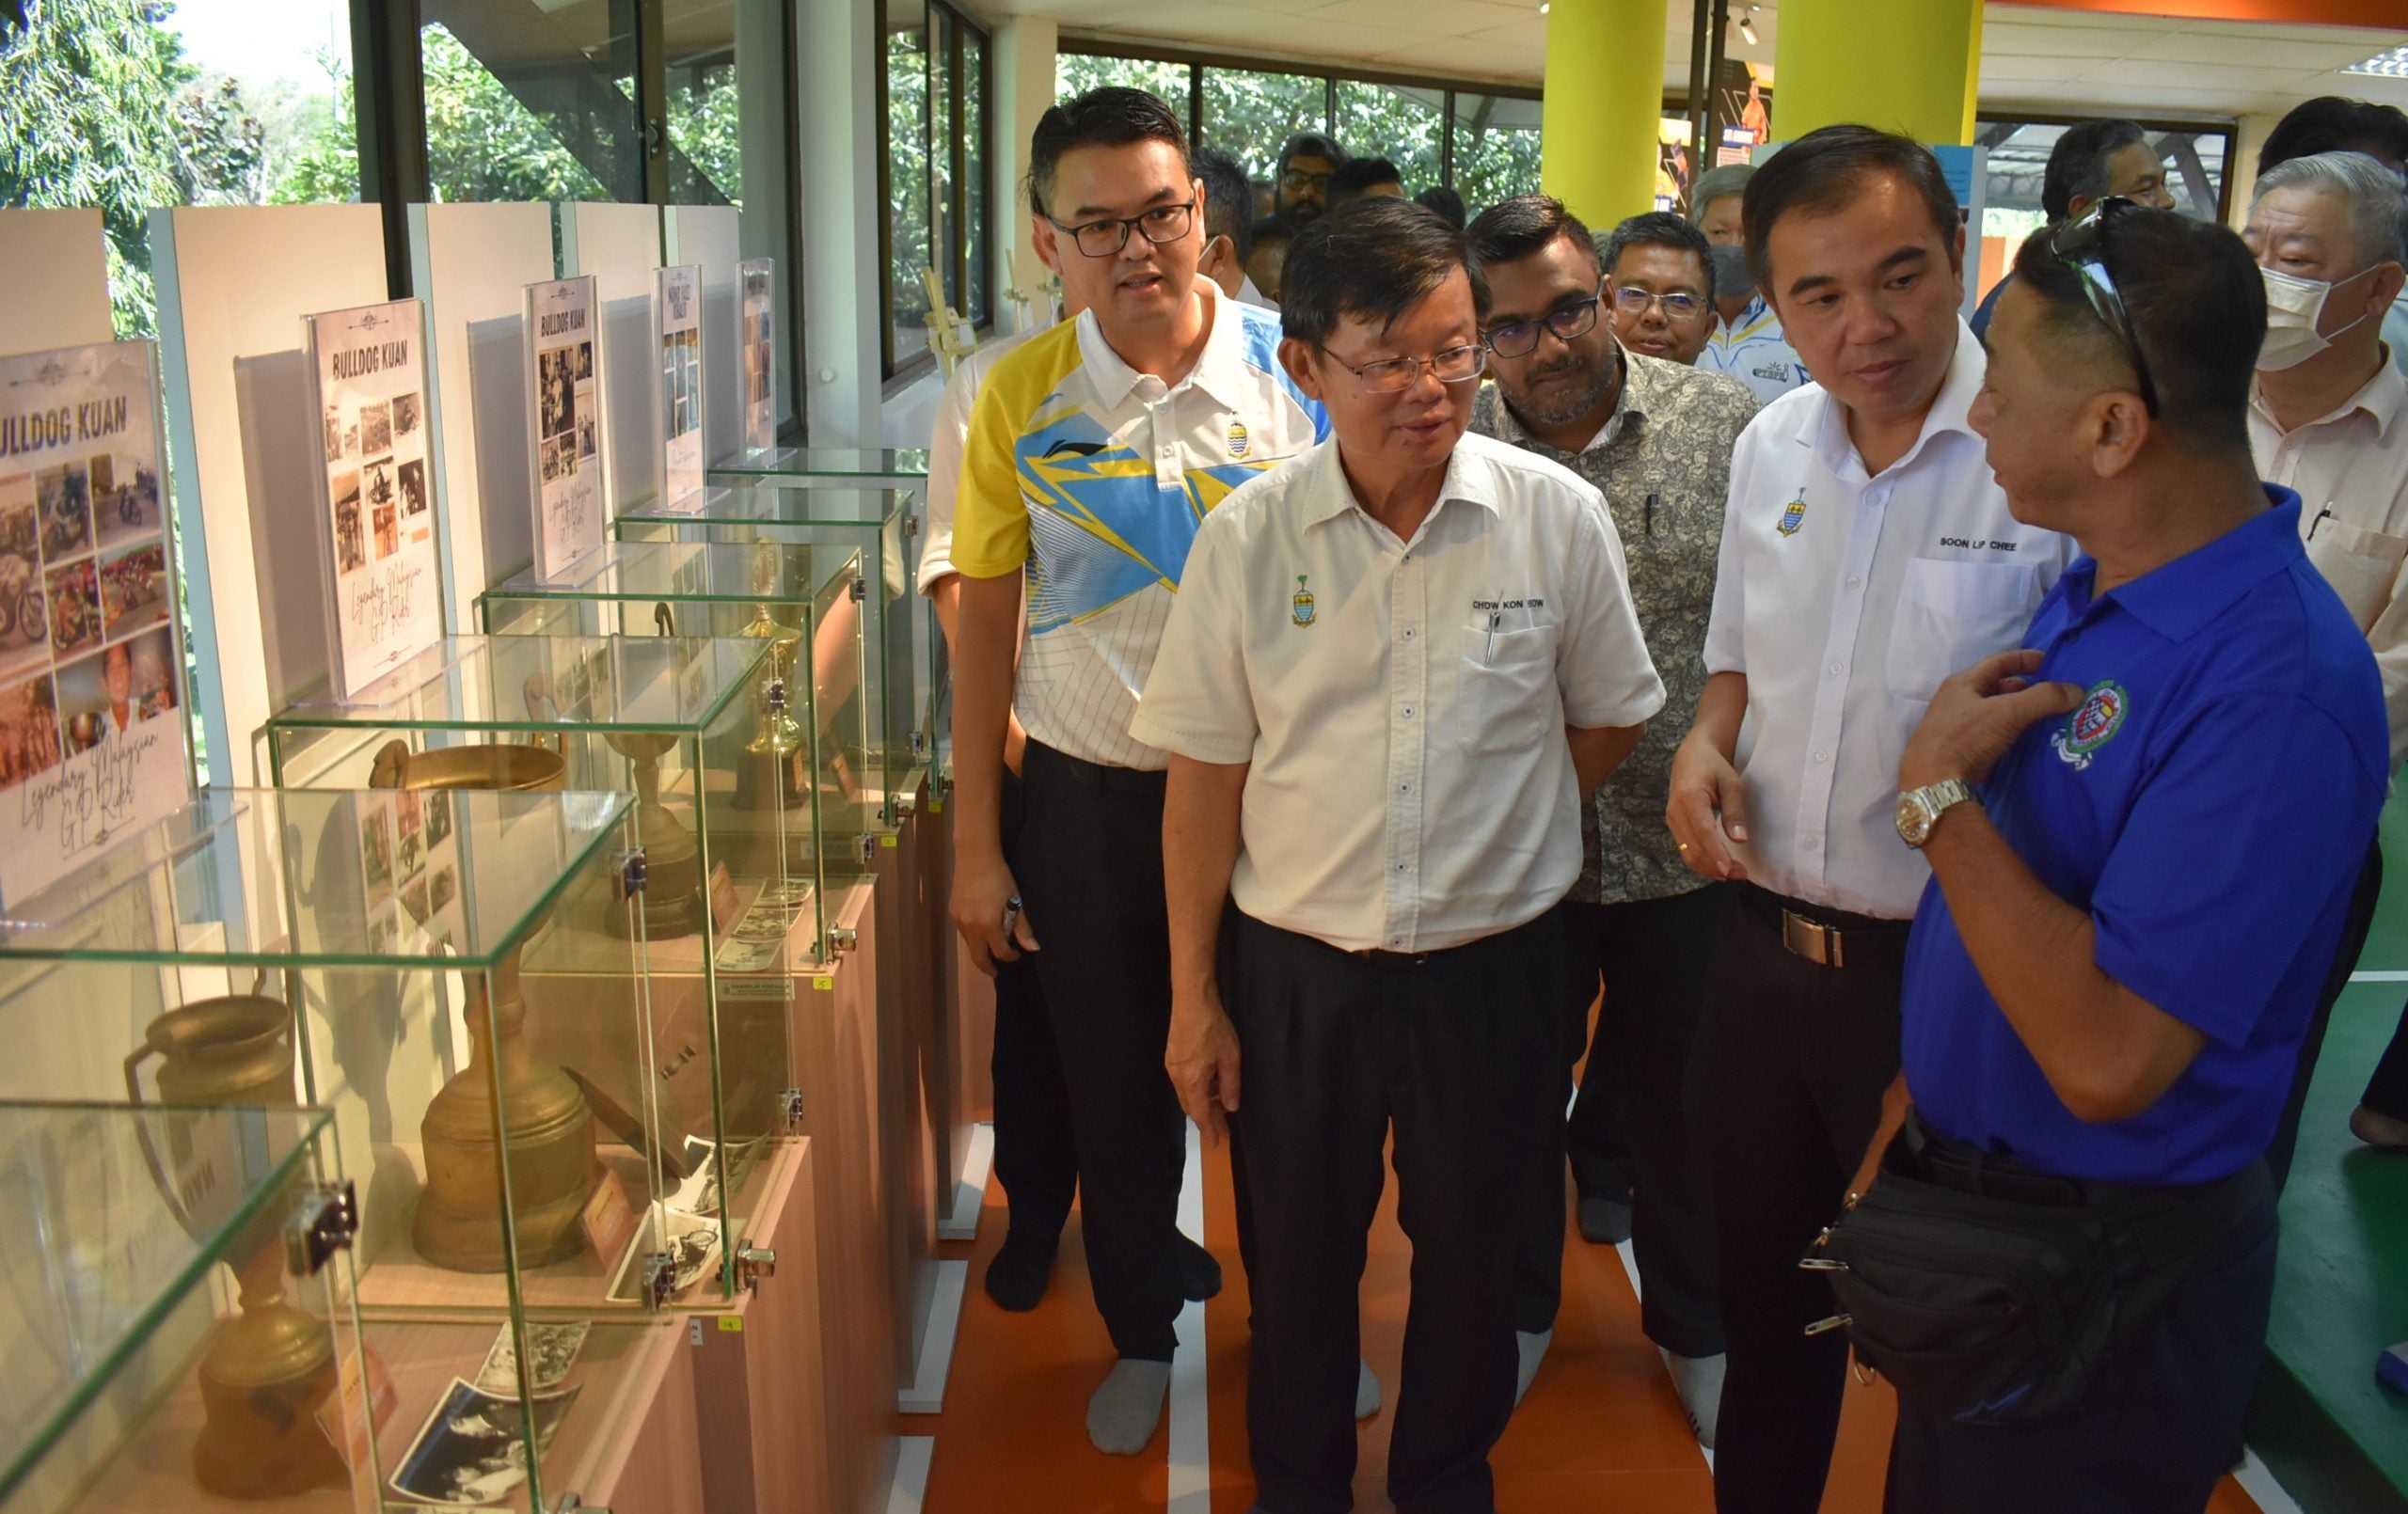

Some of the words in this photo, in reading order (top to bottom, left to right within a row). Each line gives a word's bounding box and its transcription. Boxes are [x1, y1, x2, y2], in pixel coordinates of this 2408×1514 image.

[542, 311, 568, 338] BULLDOG
[570, 308, 585, 331] KUAN
[333, 345, 379, 381] BULLDOG
[382, 339, 407, 370] KUAN
[0, 406, 71, 457] ULLDOG
[78, 395, 127, 441] KUAN
[1940, 537, 1970, 548] SOON
[1989, 541, 2017, 552] CHEE
[1472, 600, 1499, 610] CHOW
[1503, 600, 1523, 609] KON
[22, 758, 87, 831] Legendary
